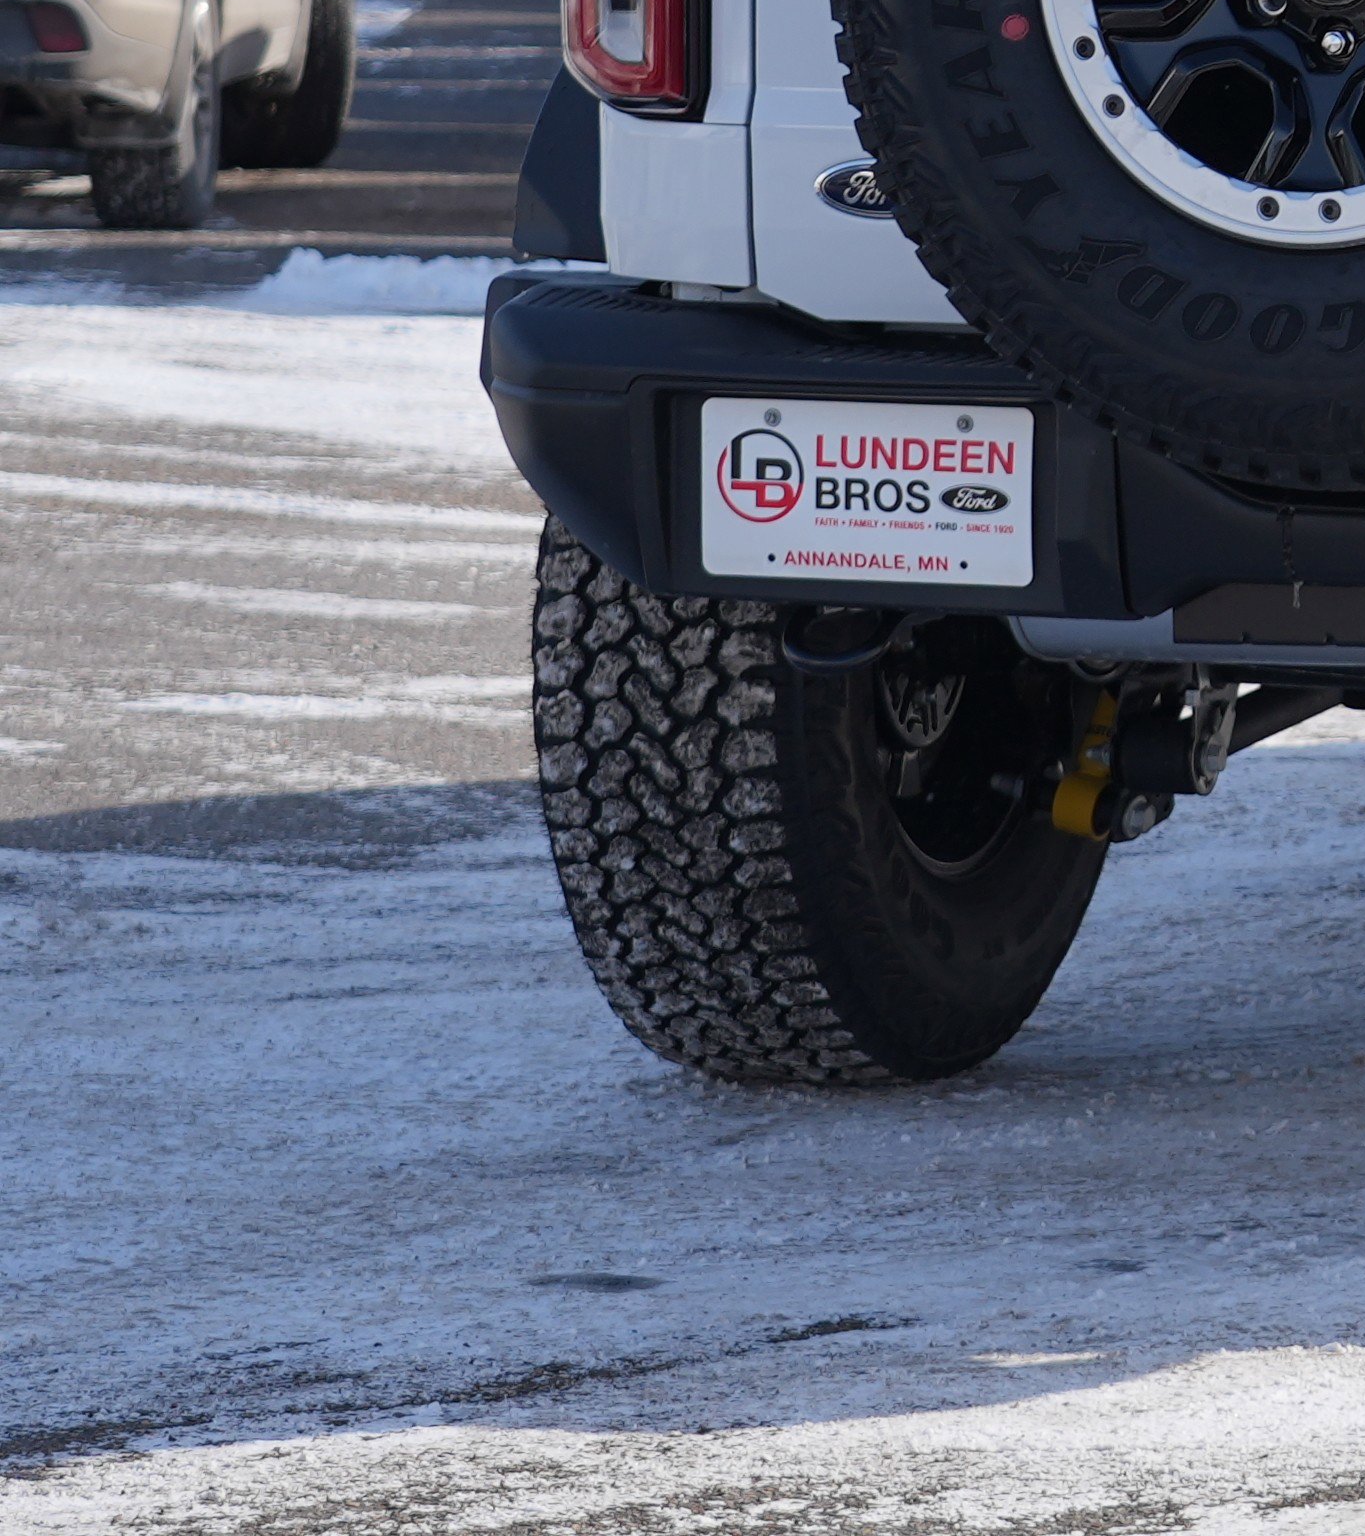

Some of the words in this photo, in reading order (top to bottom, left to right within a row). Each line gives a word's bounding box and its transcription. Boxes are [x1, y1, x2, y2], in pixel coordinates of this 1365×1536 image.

[815, 434, 1015, 475] LUNDEEN
[815, 477, 931, 514] BROS
[951, 487, 999, 511] Ford
[814, 517, 840, 528] FAITH
[848, 518, 879, 529] FAMILY
[888, 520, 925, 531] FRIENDS
[934, 521, 958, 532] FORD
[965, 523, 991, 534] SINCE
[784, 550, 911, 574] ANNANDALE,
[918, 556, 949, 572] MN
